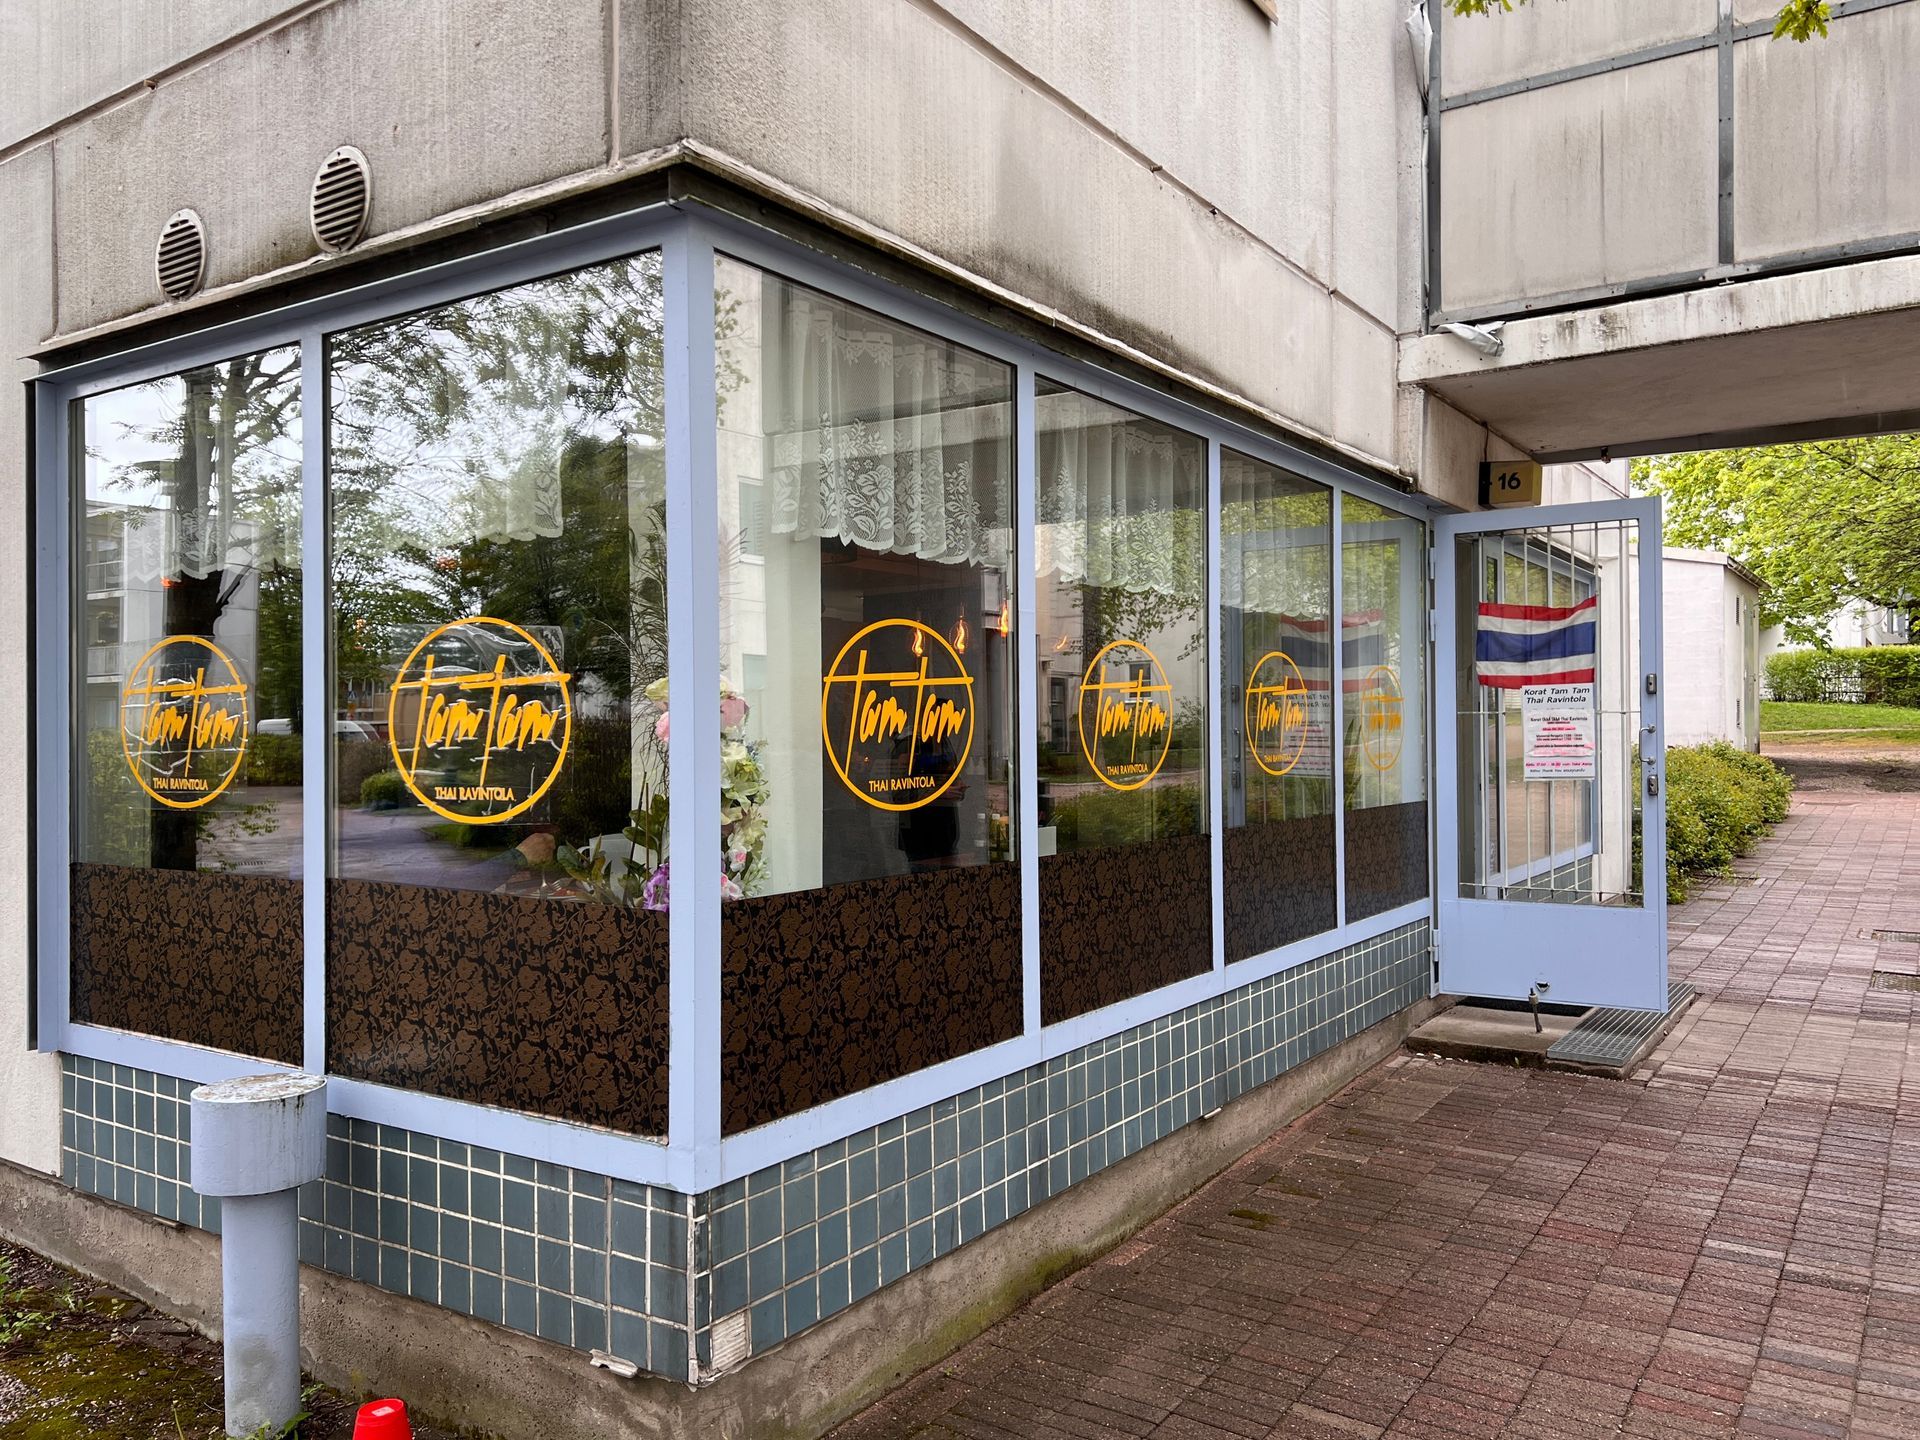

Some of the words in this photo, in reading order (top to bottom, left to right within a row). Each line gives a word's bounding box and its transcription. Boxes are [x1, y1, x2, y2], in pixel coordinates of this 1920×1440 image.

[1497, 471, 1521, 490] 16
[1524, 688, 1547, 696] Korat
[1547, 695, 1587, 704] Ravintola
[1107, 766, 1120, 775] THAI
[1120, 763, 1148, 775] RAVINTOLA
[153, 777, 169, 790] THAI
[170, 778, 208, 790] RAVINTOLA
[868, 779, 888, 792] THAI
[890, 776, 935, 791] RAVINTOLA
[434, 786, 456, 800] THAI
[459, 787, 515, 801] RAVINTOLA
